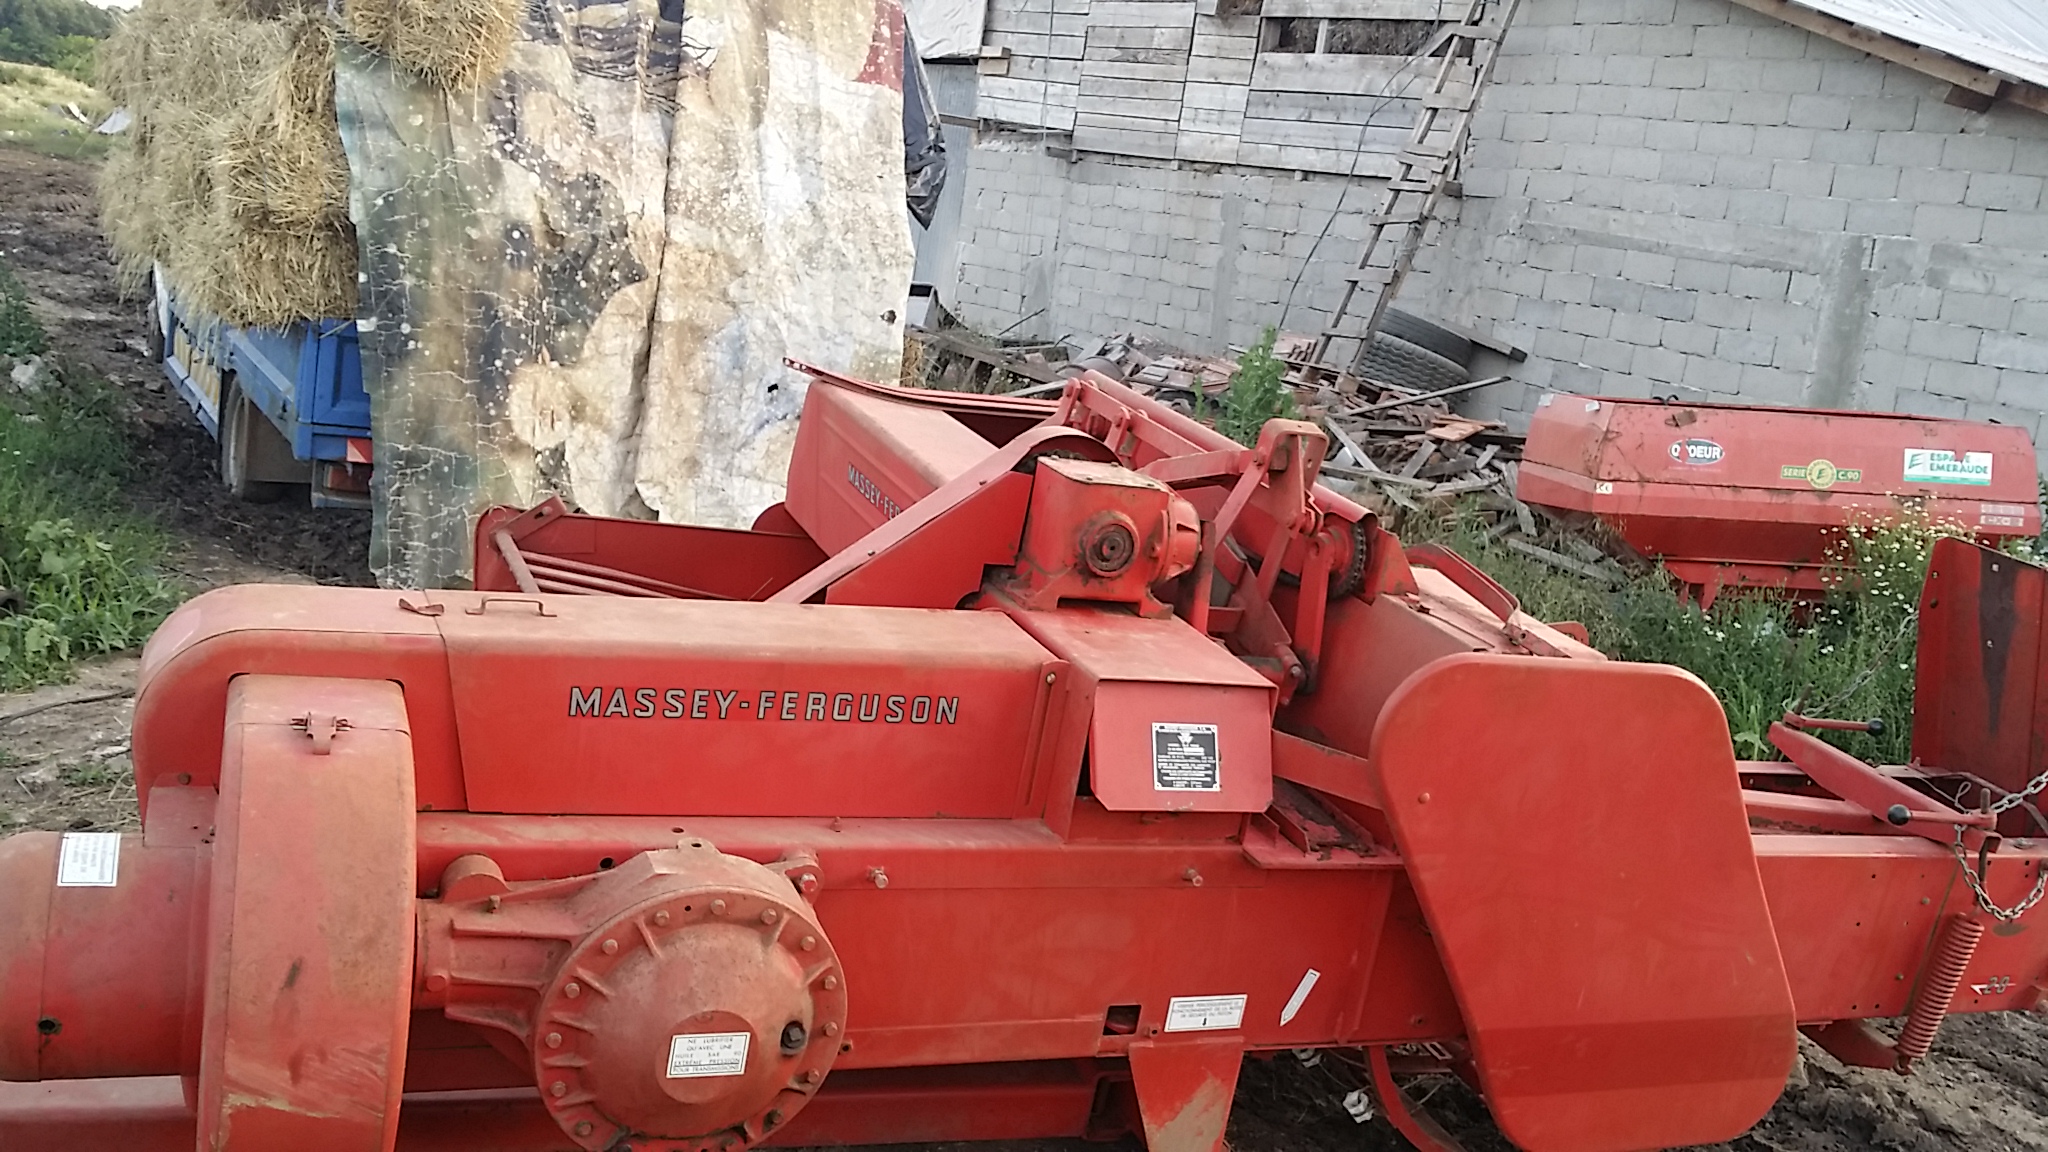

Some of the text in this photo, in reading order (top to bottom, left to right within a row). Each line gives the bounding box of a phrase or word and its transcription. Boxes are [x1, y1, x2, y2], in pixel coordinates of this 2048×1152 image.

[1929, 452, 1971, 463] ESPAE
[1782, 467, 1806, 478] SERIE
[1929, 462, 1988, 474] EMERAUDE
[568, 686, 959, 724] MASSEY-FERGUSON
